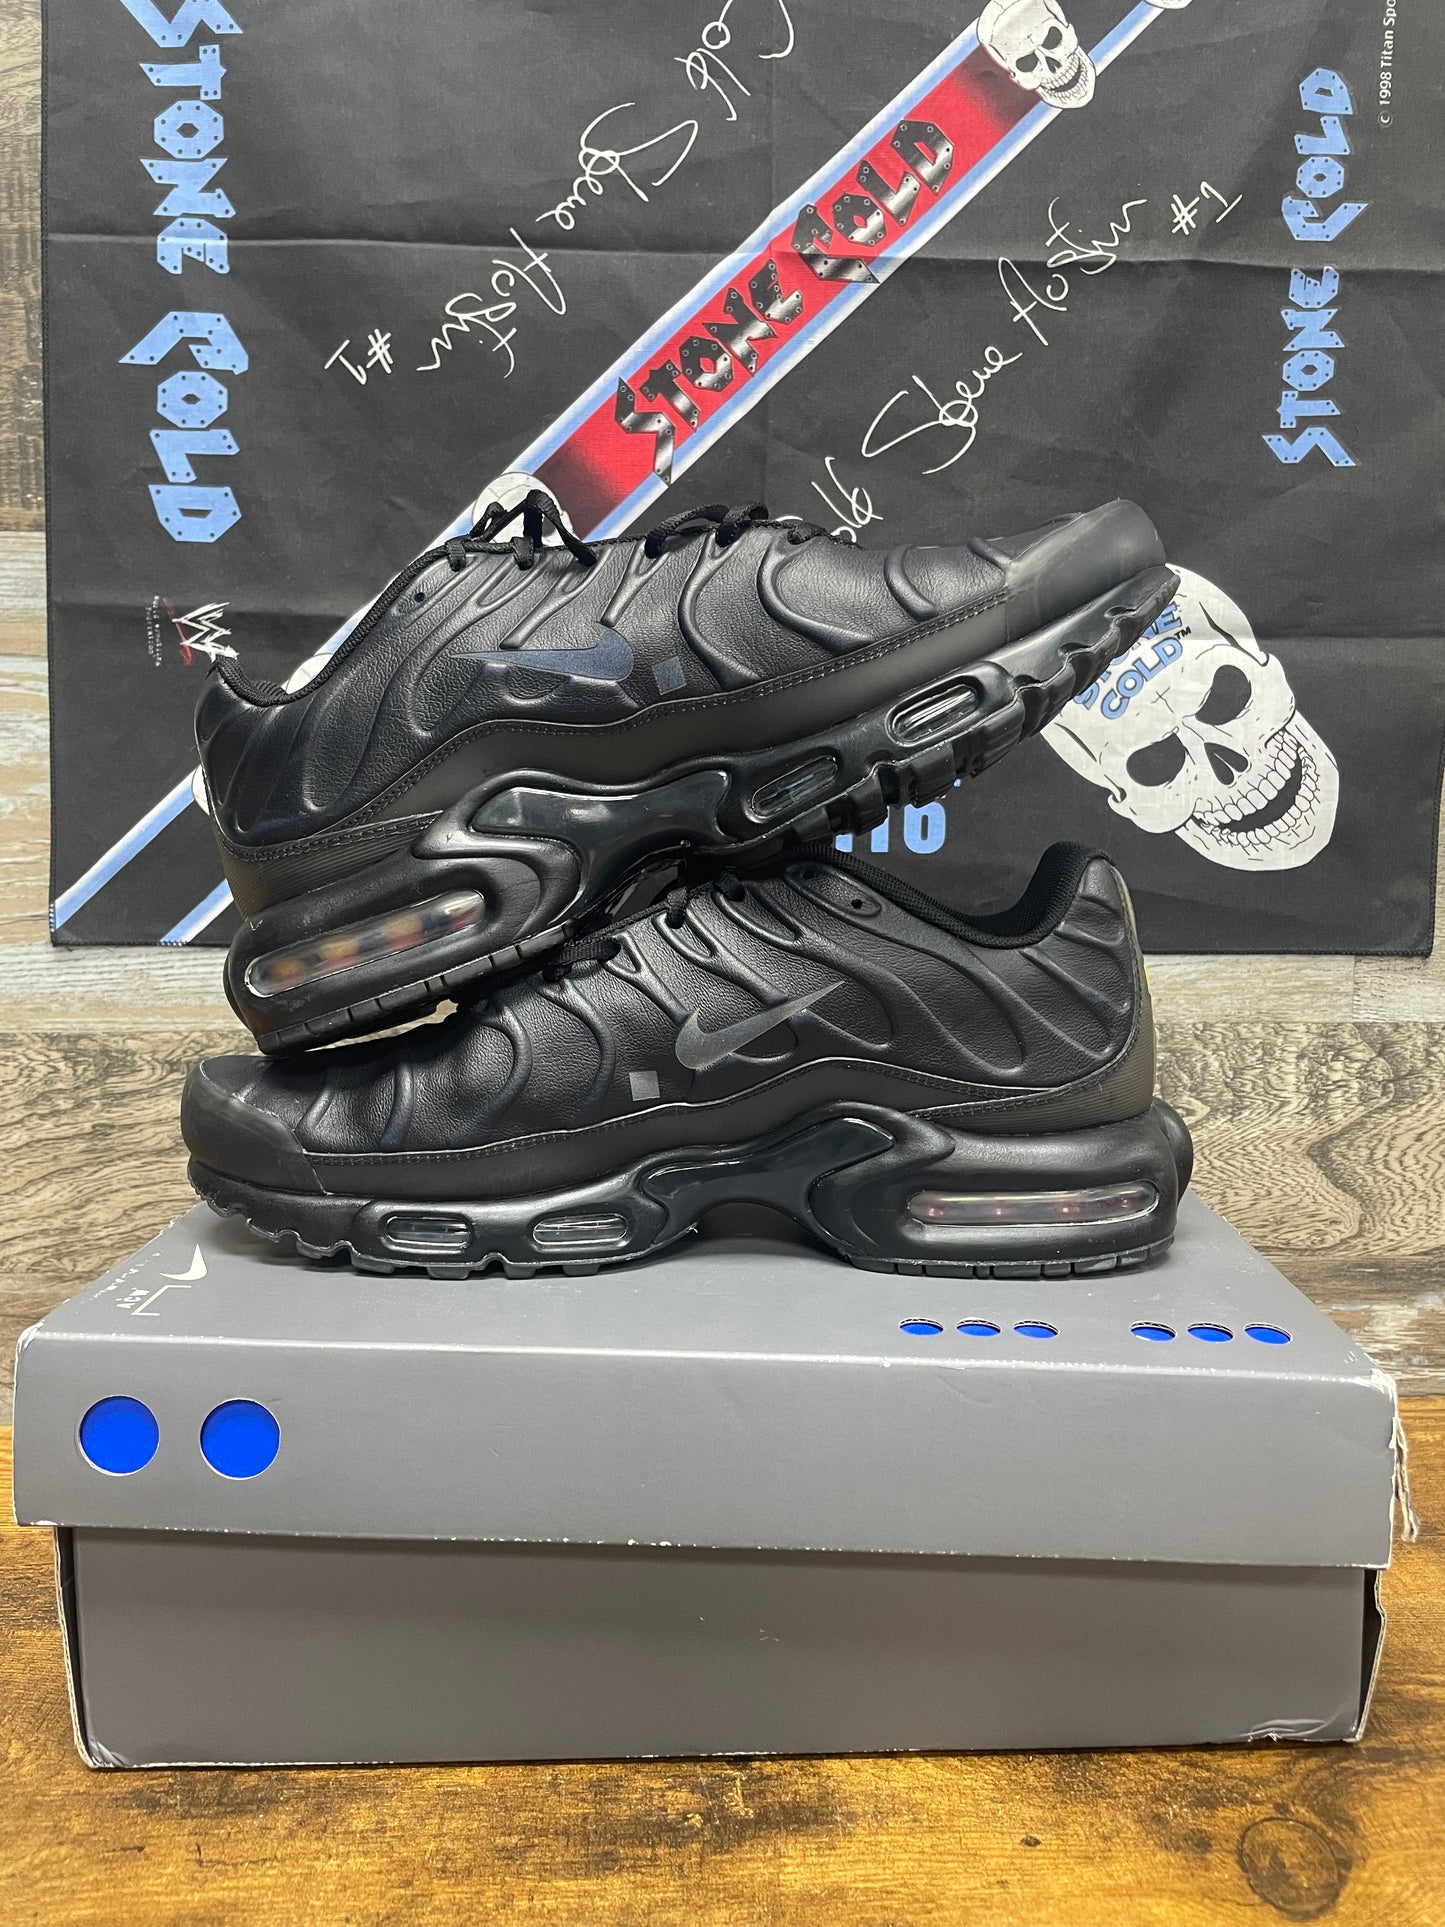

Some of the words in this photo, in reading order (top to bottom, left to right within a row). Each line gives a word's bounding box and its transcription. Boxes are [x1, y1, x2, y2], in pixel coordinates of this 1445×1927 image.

[1379, 71, 1393, 105] 1998
[1380, 30, 1394, 68] Titan
[119, 0, 243, 274] STONE
[1170, 181, 1243, 236] #1
[1281, 68, 1368, 241] COLD
[324, 328, 394, 385] #1
[614, 258, 803, 484] STONE
[790, 119, 954, 284] COLD
[1262, 267, 1357, 468] STONE
[119, 310, 249, 543] COLD
